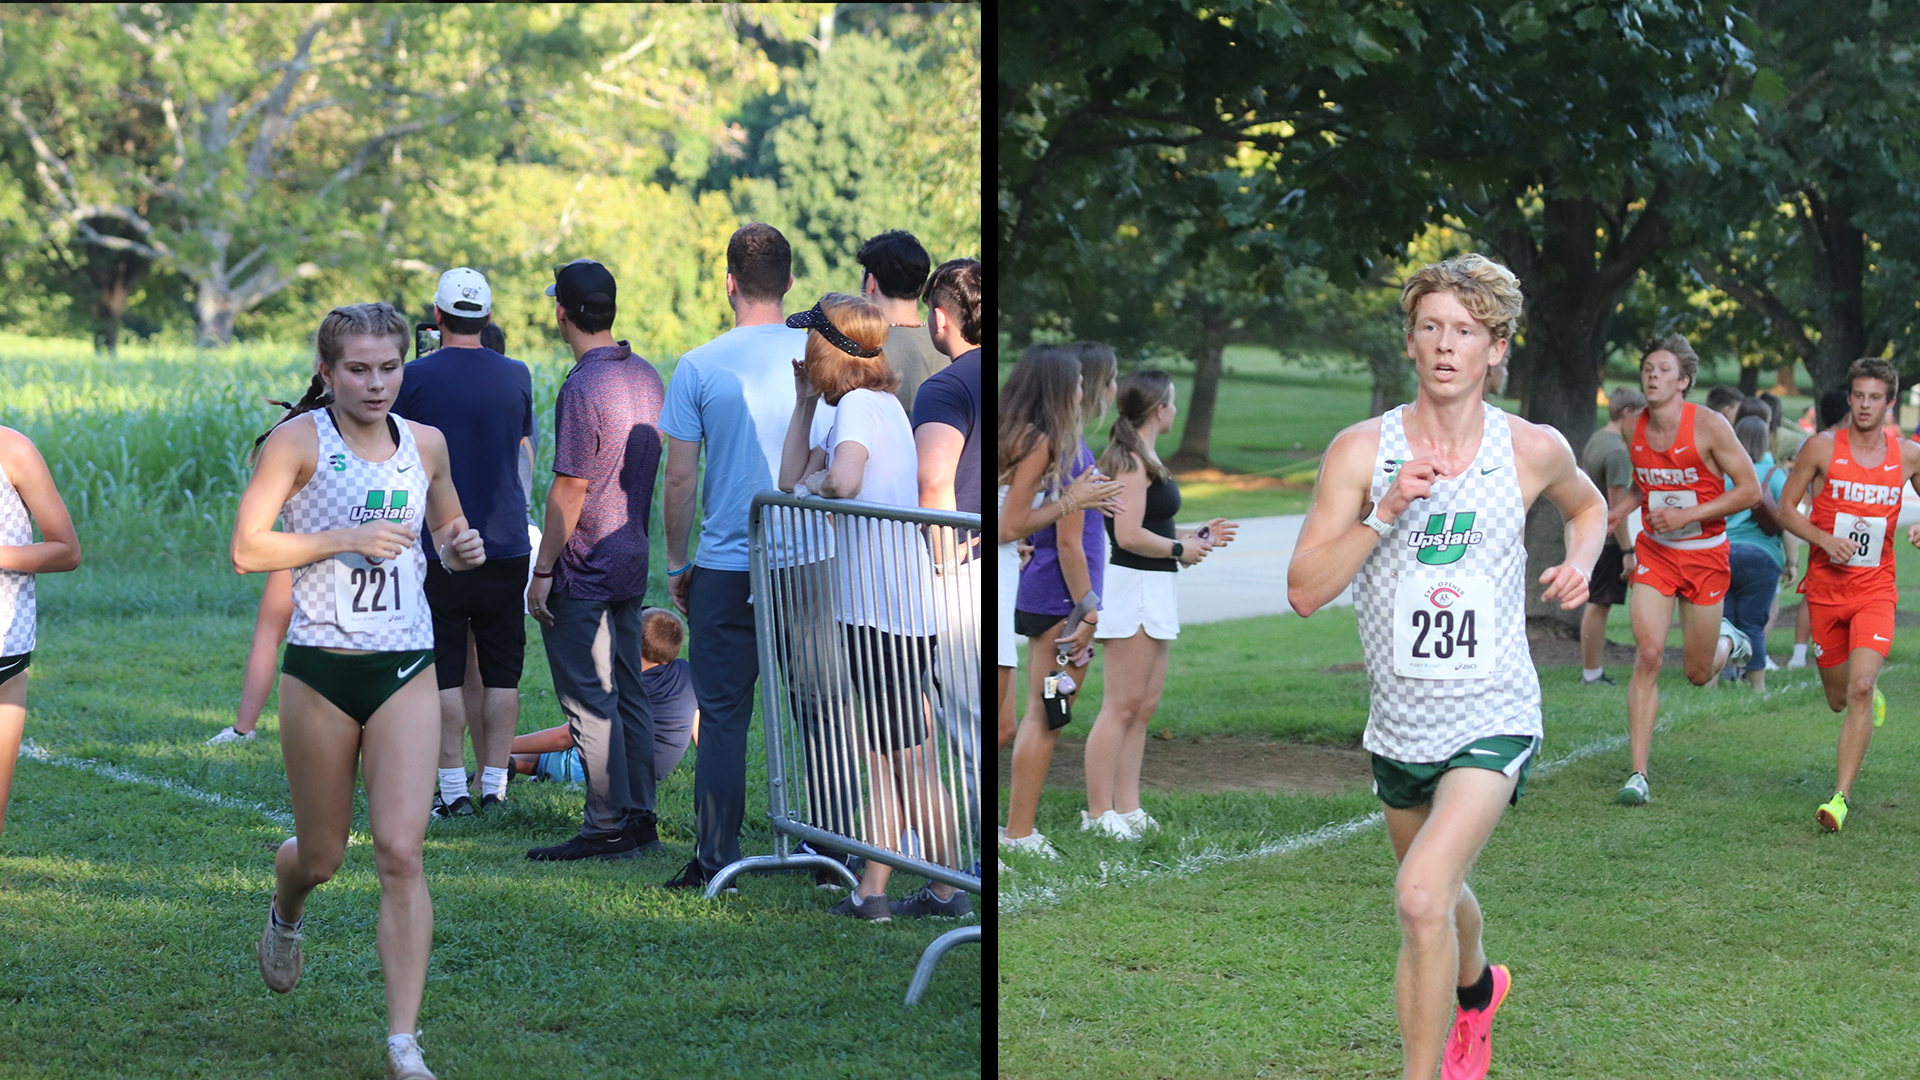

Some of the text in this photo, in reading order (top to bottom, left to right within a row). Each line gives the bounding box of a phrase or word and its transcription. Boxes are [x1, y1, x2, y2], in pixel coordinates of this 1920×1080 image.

[1635, 467, 1699, 485] TIGERS
[1829, 479, 1901, 506] TIGERS
[350, 505, 415, 521] Upstate
[1407, 529, 1483, 549] Upstate
[351, 566, 400, 612] 221
[1412, 609, 1477, 659] 234
